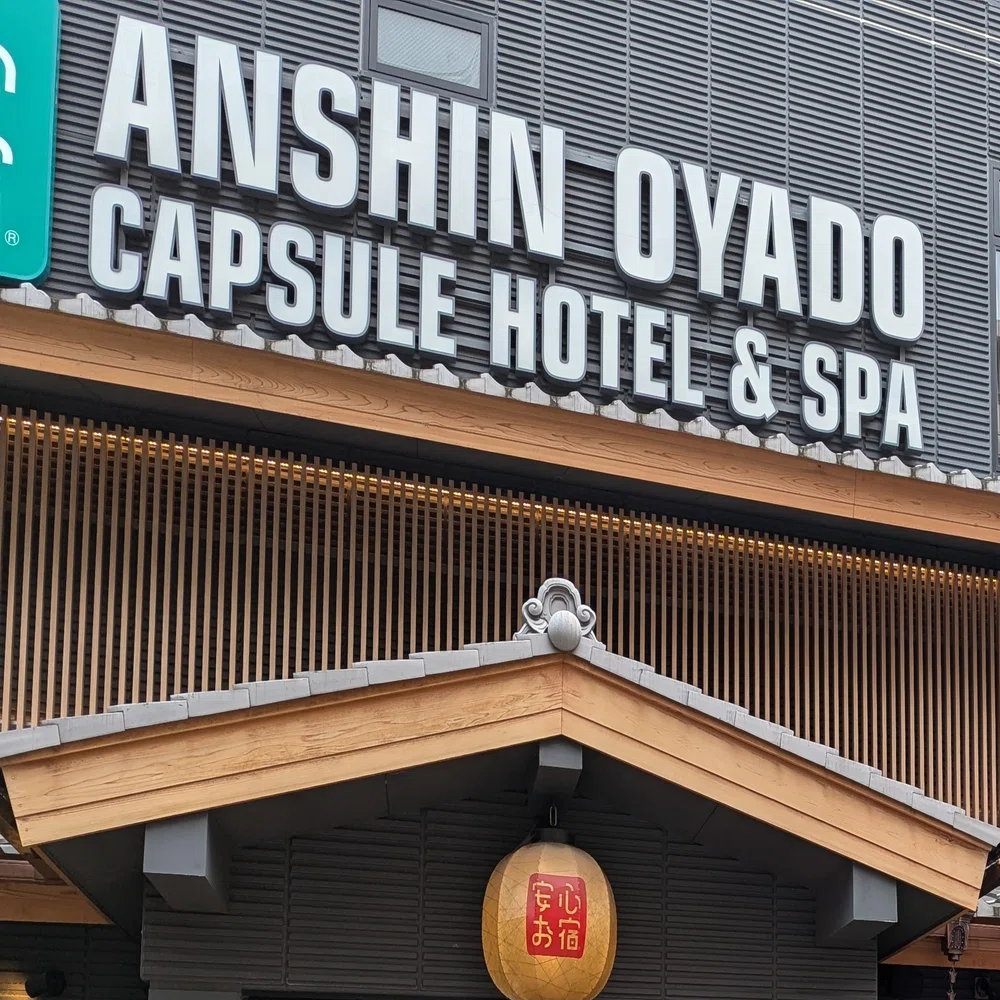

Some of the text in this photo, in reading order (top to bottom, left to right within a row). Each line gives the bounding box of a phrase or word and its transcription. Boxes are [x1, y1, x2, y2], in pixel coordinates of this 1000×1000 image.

[88, 183, 923, 453] CAPSULE HOTEL & SPA
[94, 14, 926, 345] ANSHIN OYADO
